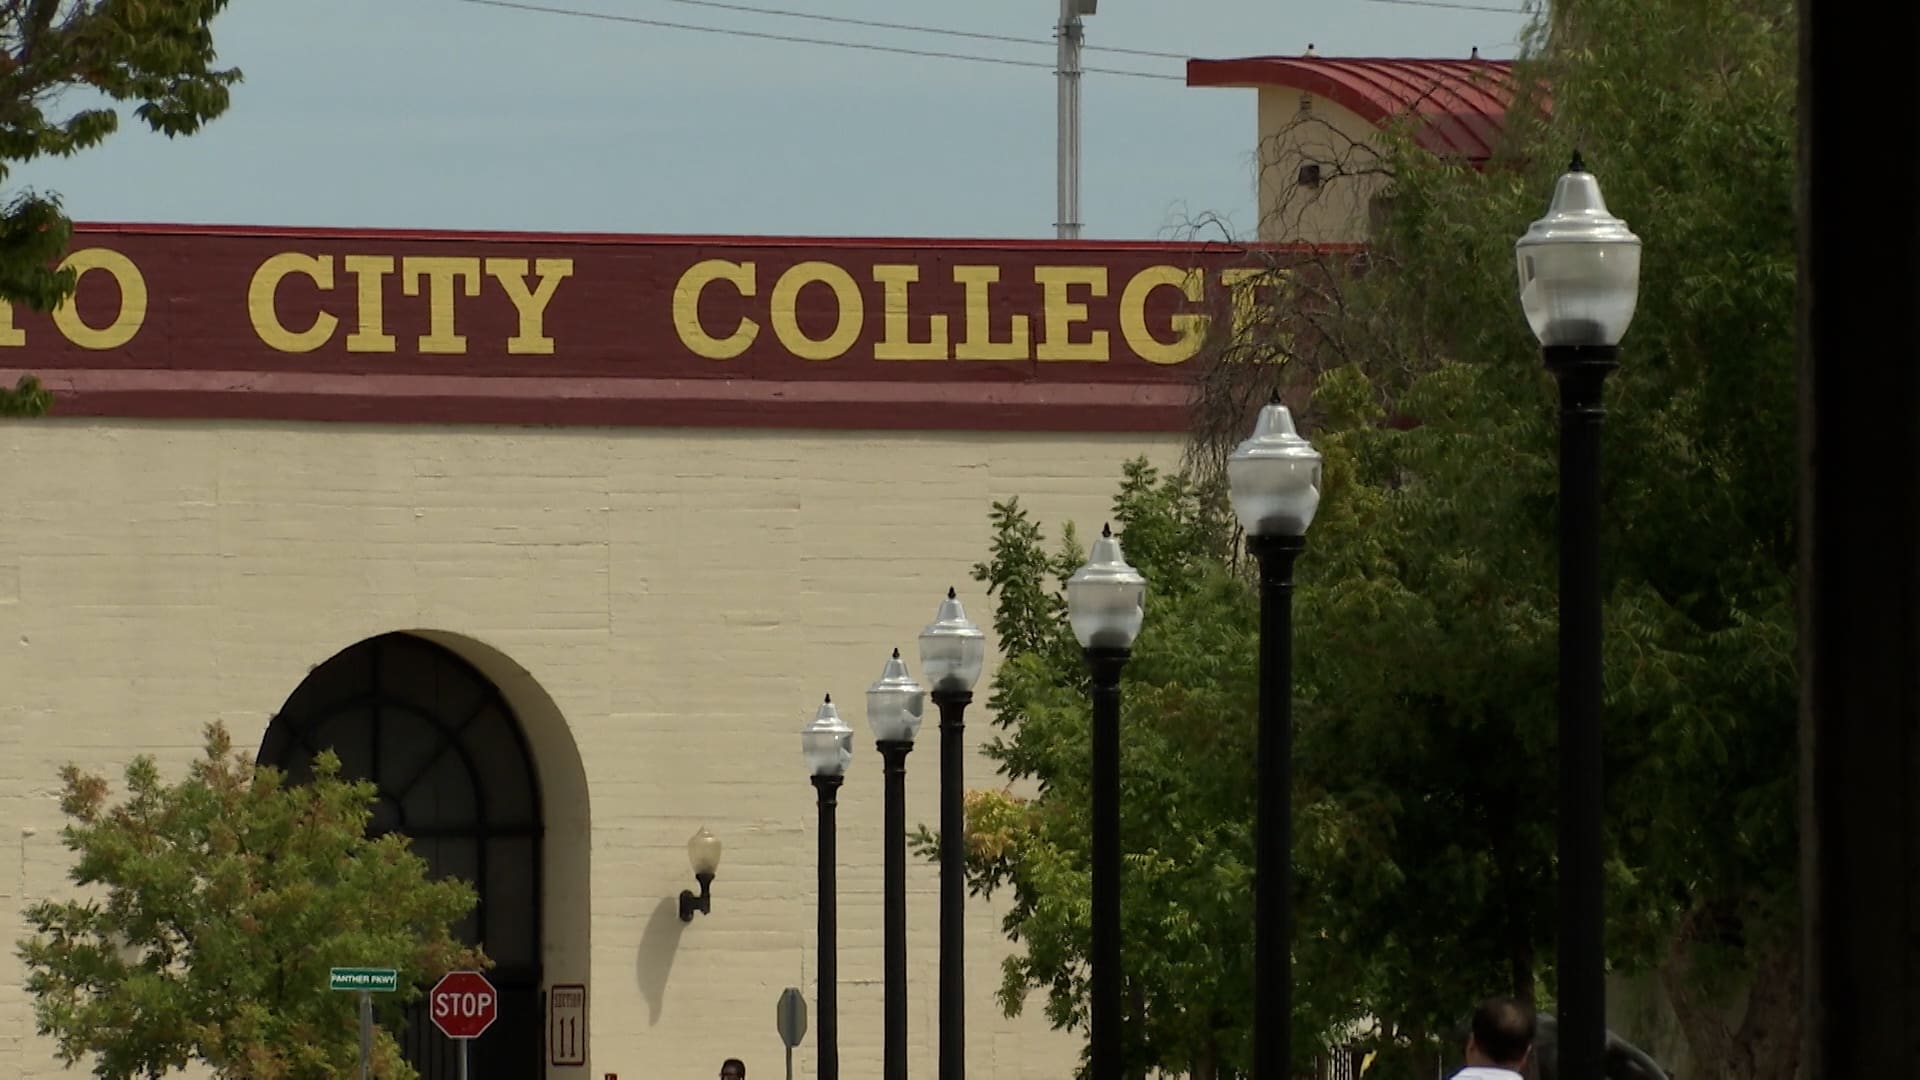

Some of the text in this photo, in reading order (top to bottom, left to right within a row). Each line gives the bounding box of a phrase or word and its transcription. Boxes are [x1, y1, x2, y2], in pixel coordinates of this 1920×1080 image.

[249, 253, 573, 354] CITY
[673, 260, 1295, 364] COLLEGE
[331, 974, 394, 985] PANTHER PKWY
[436, 993, 491, 1017] STOP
[560, 1016, 576, 1058] 11
